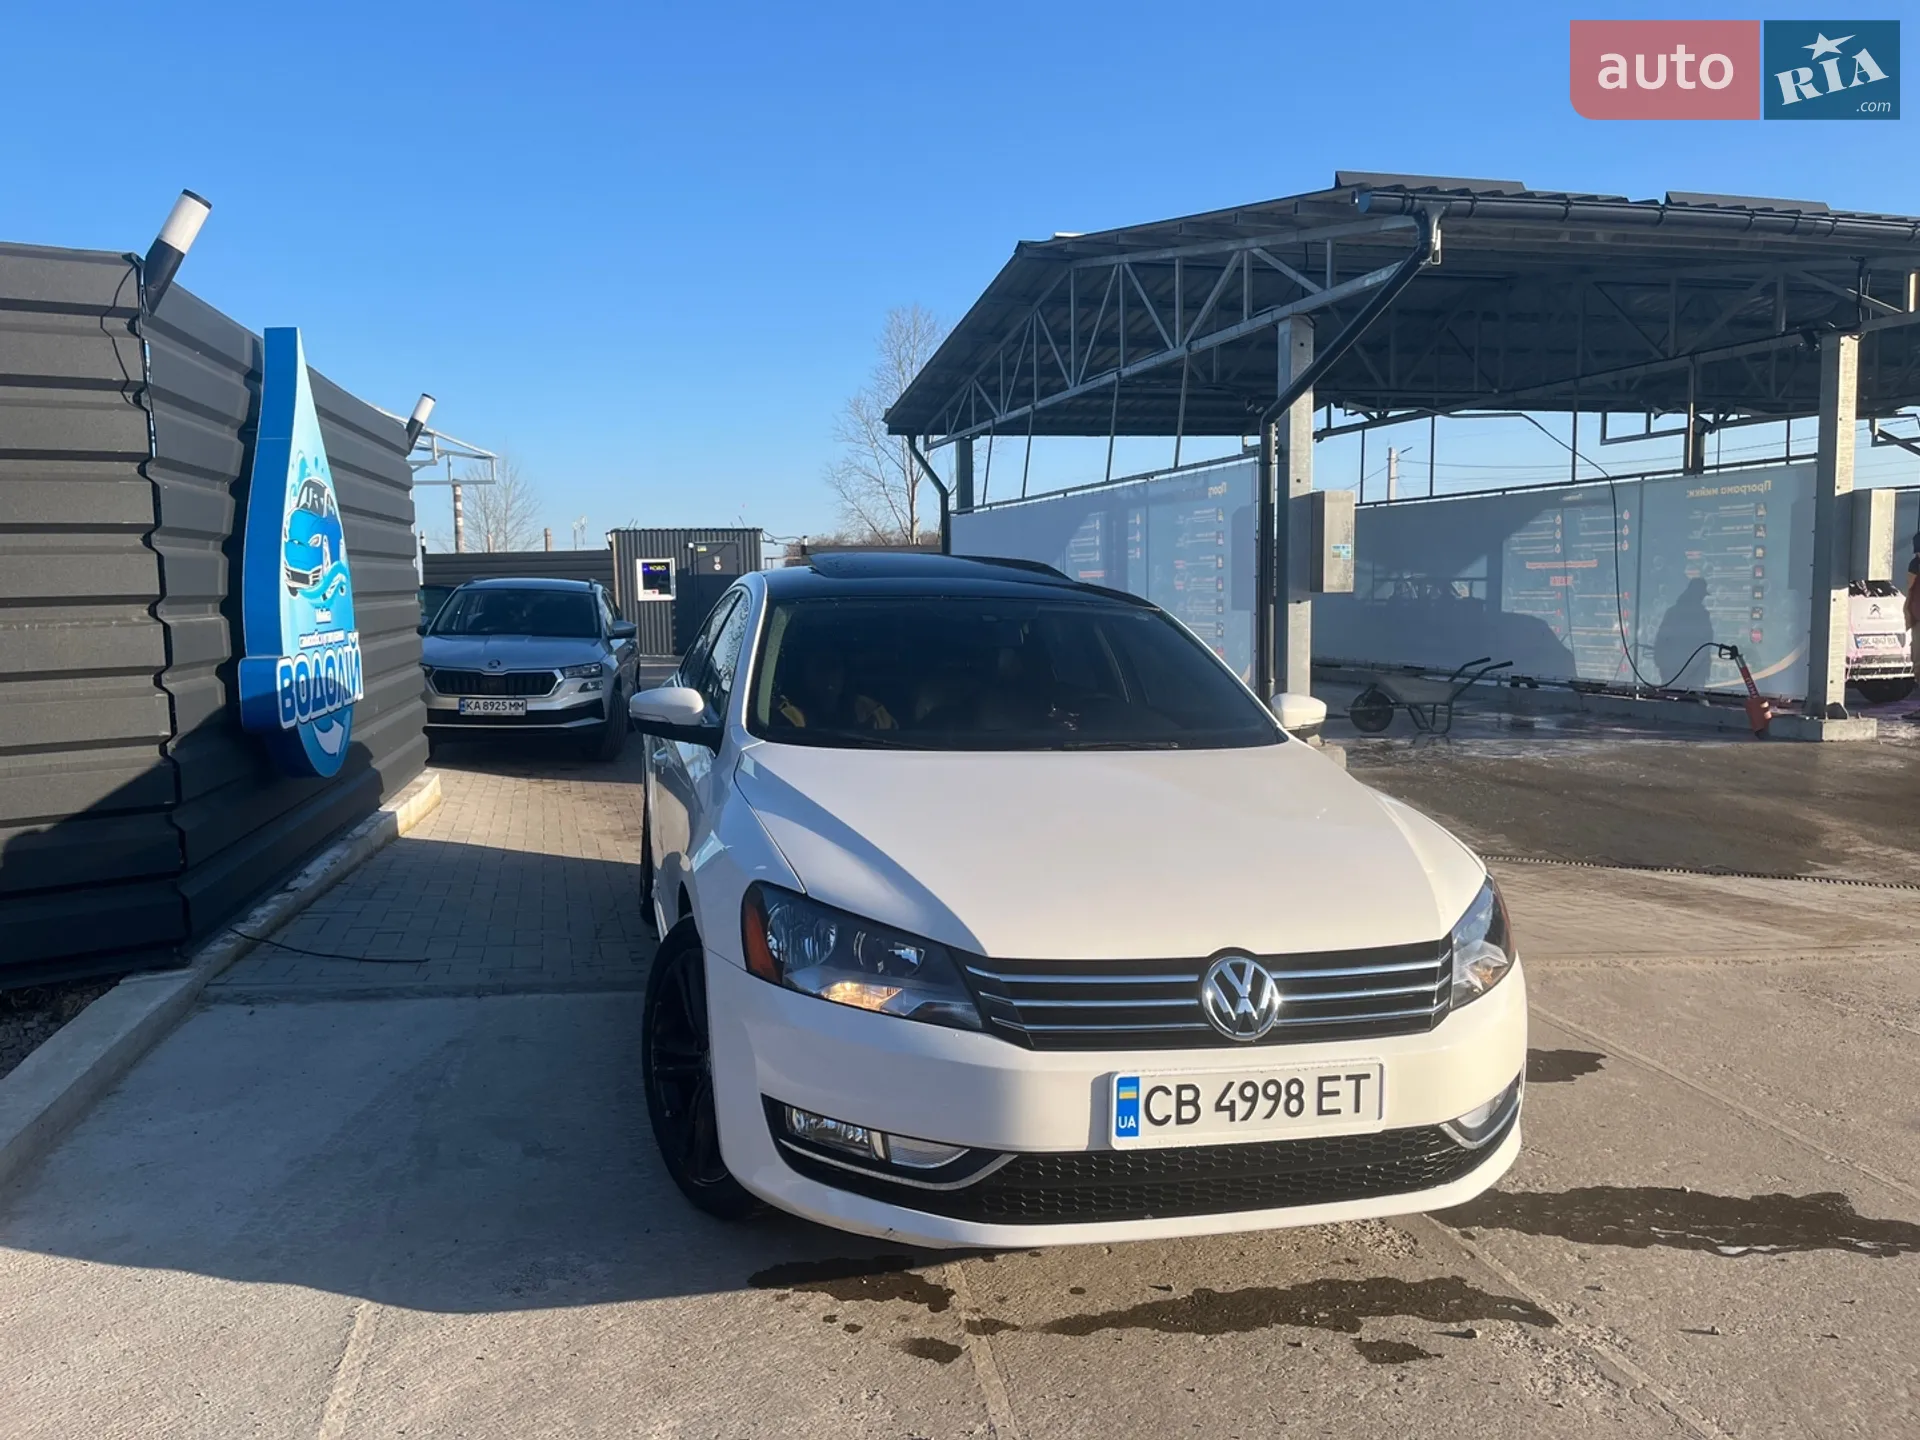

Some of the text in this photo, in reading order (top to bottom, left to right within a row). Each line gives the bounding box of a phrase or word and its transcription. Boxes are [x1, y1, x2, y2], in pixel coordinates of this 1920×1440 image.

[277, 632, 363, 729] ВОДОЛІЙ
[466, 701, 524, 711] KA 8925 MM
[1143, 1073, 1371, 1127] CB 4998 ET
[1118, 1115, 1136, 1128] UA
